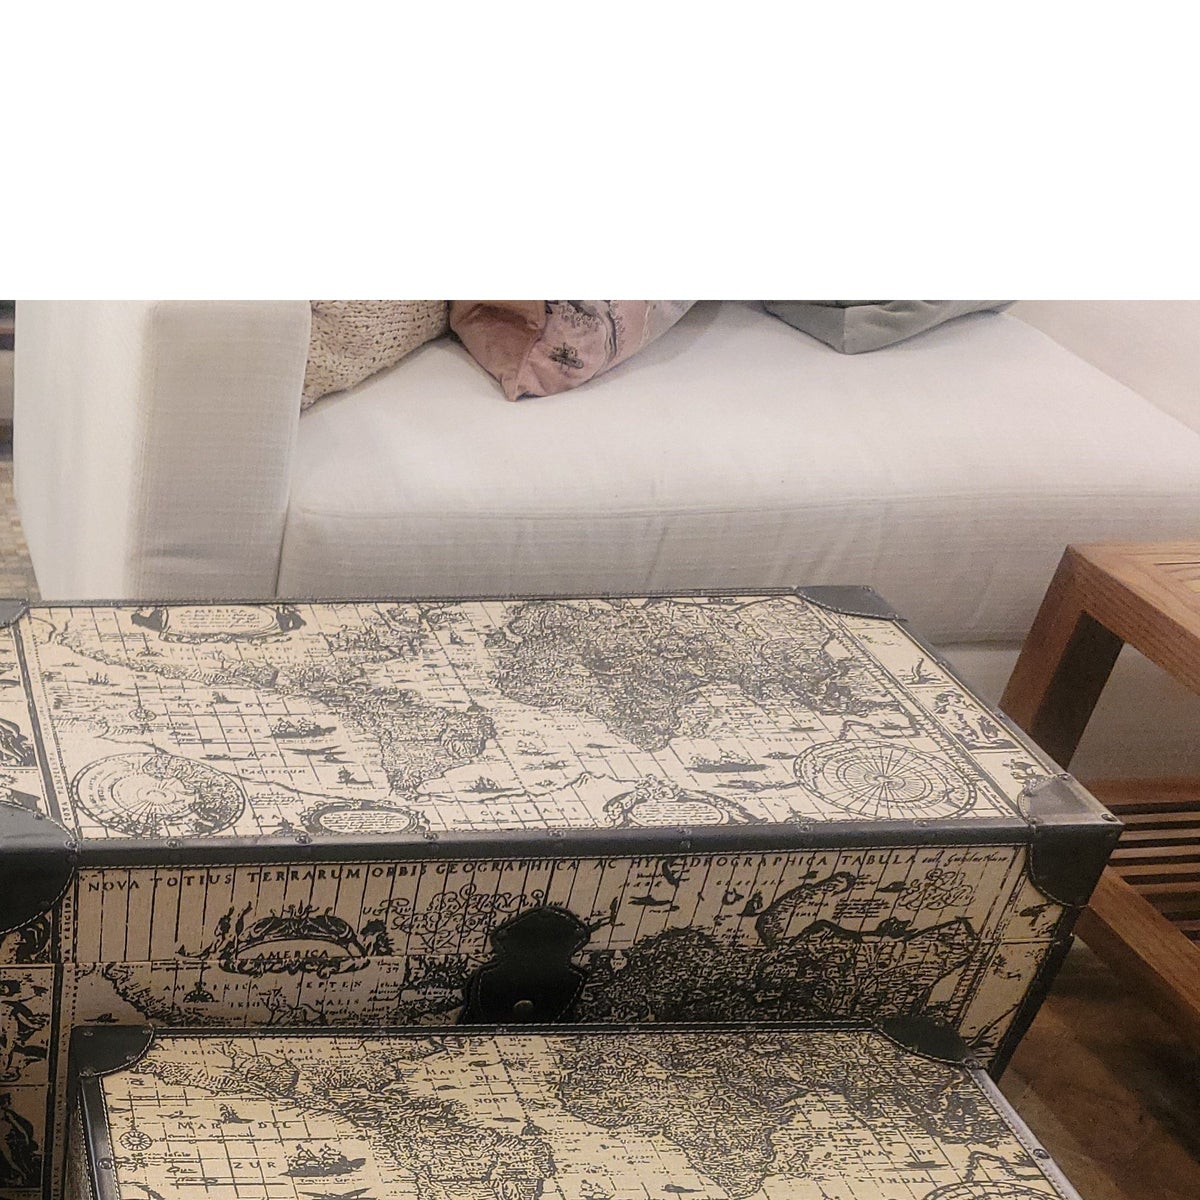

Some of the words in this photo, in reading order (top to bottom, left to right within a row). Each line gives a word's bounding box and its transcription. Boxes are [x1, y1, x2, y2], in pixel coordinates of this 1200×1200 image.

[88, 880, 140, 892] NOVA
[149, 874, 232, 887] TOTIUS
[247, 868, 361, 883] TERRARUM
[372, 864, 428, 877] ORBIS
[436, 859, 578, 874] GEOGRAPHICA
[594, 857, 616, 869] AC
[841, 854, 919, 866] TABULA
[256, 949, 329, 959] AMERICA
